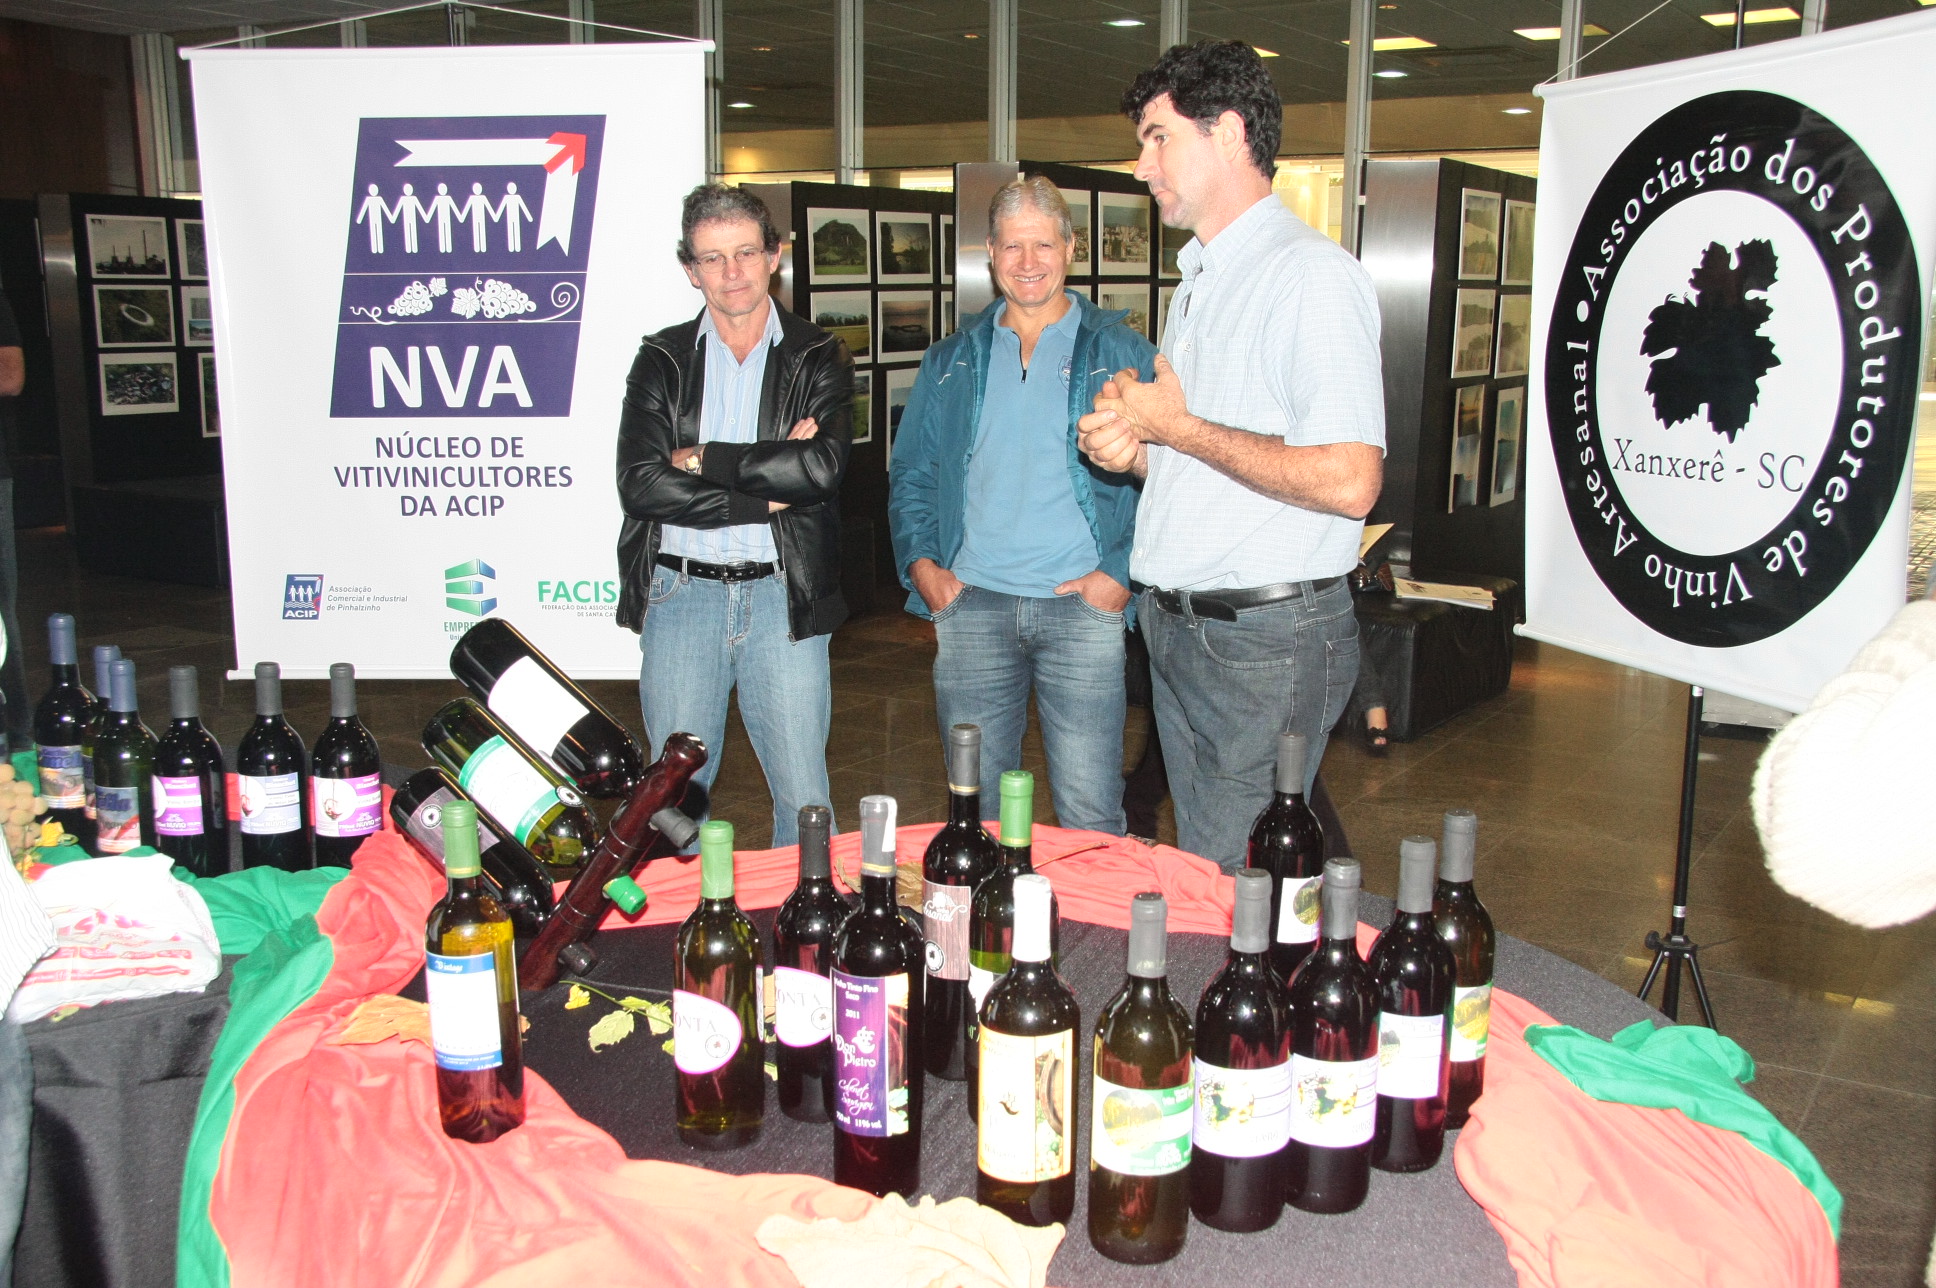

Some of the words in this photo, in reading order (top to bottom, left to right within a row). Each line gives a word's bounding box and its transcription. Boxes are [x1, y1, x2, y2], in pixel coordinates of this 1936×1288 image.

[1764, 137, 1835, 212] dos
[1583, 132, 1751, 301] Associação
[1812, 203, 1901, 526] Produtores
[369, 345, 534, 408] NVA
[375, 430, 482, 459] NÚCLEO
[490, 436, 525, 459] DE
[1567, 339, 1638, 557] Artesanal
[333, 465, 574, 488] VITIVINICULTORES
[1612, 438, 1725, 483] Xanxerê
[1757, 451, 1806, 493] SC
[400, 495, 438, 517] DA
[445, 495, 505, 517] ACIP
[1763, 530, 1809, 577] de
[328, 585, 372, 594] Associação
[537, 580, 618, 603] FACIS
[1644, 554, 1754, 609] Vinho
[327, 594, 365, 602] Comercial
[373, 594, 408, 602] Industrial
[337, 603, 381, 611] Pinhalzinho
[541, 603, 575, 612] FEDERAÇÃO
[284, 609, 318, 618] ACIP
[444, 621, 480, 632] EMPRE
[845, 1008, 860, 1019] 2011
[835, 1034, 856, 1054] Don
[844, 1050, 877, 1067] Pietro
